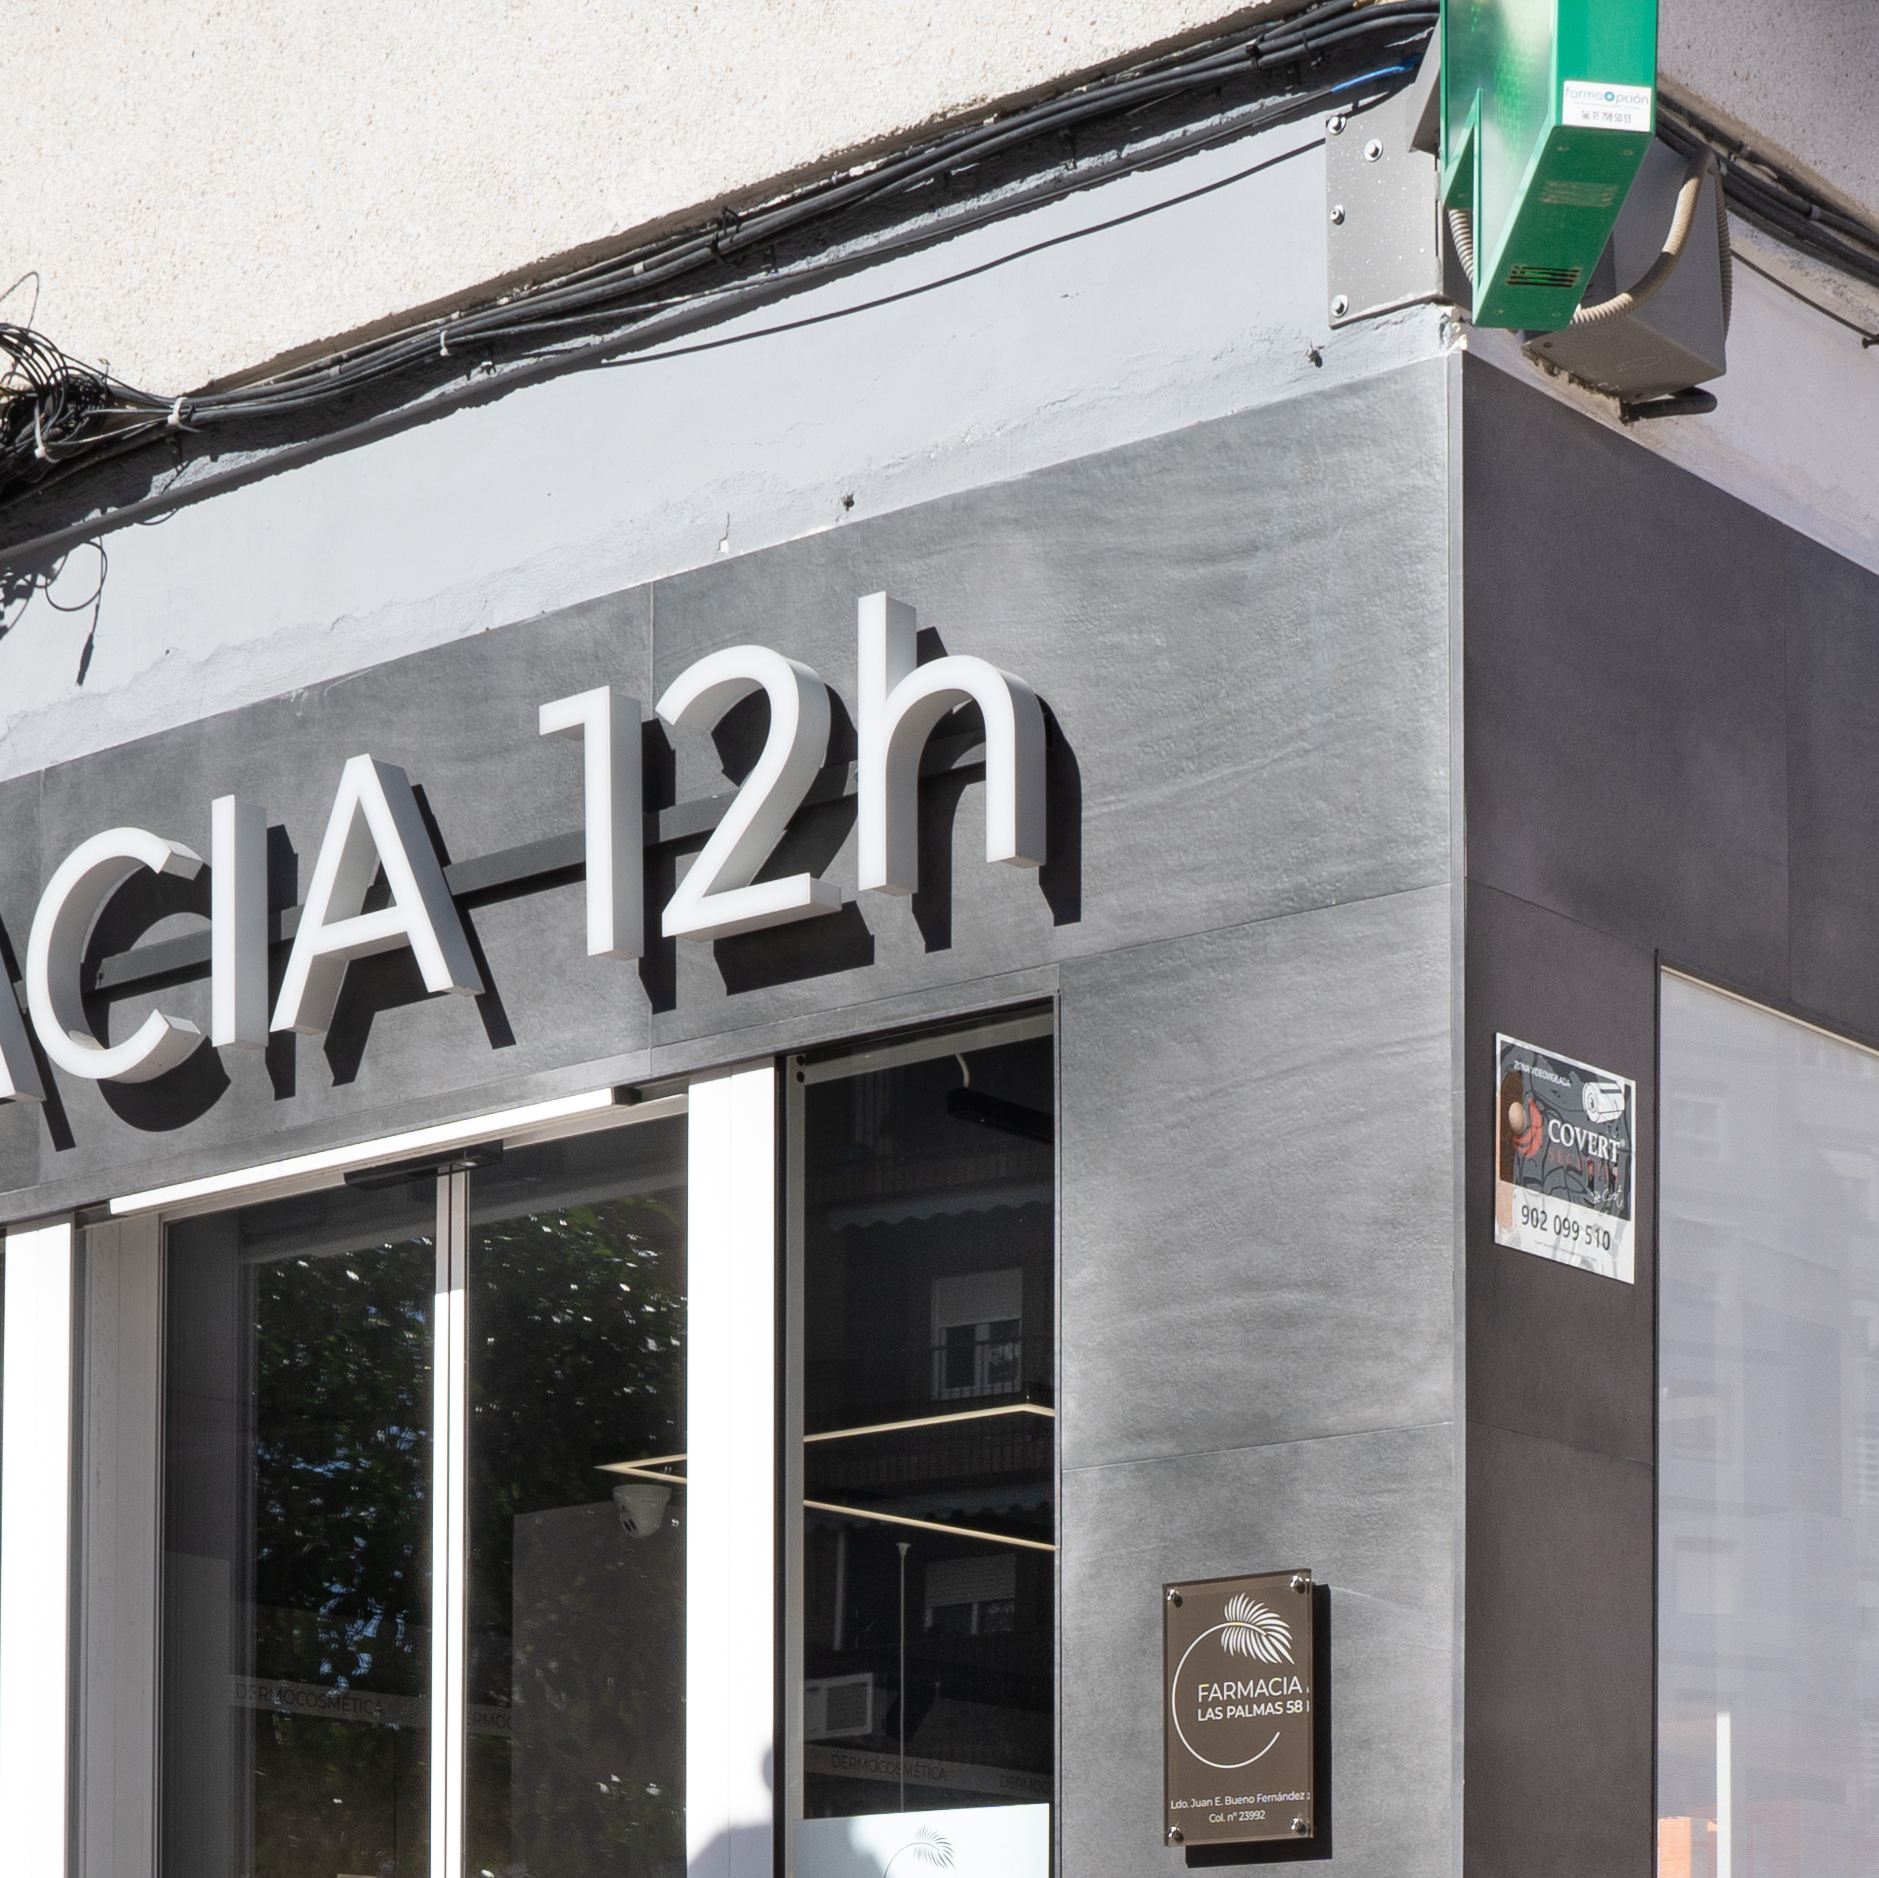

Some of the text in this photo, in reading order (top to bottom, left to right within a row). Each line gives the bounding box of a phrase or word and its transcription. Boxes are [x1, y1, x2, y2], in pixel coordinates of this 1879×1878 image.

[538, 590, 1047, 961] 12h
[1547, 1118, 1621, 1163] COVERT
[1520, 1204, 1548, 1232] 902
[1553, 1216, 1580, 1242] 099
[1585, 1225, 1611, 1251] 510
[1197, 1676, 1303, 1702] FARMACIA
[1197, 1700, 1303, 1722] LAS PALMAS 58
[1190, 1798, 1213, 1809] Juan
[1225, 1795, 1255, 1807] Bueno
[1256, 1791, 1305, 1804] Fernández
[1239, 1810, 1266, 1822] 23992
